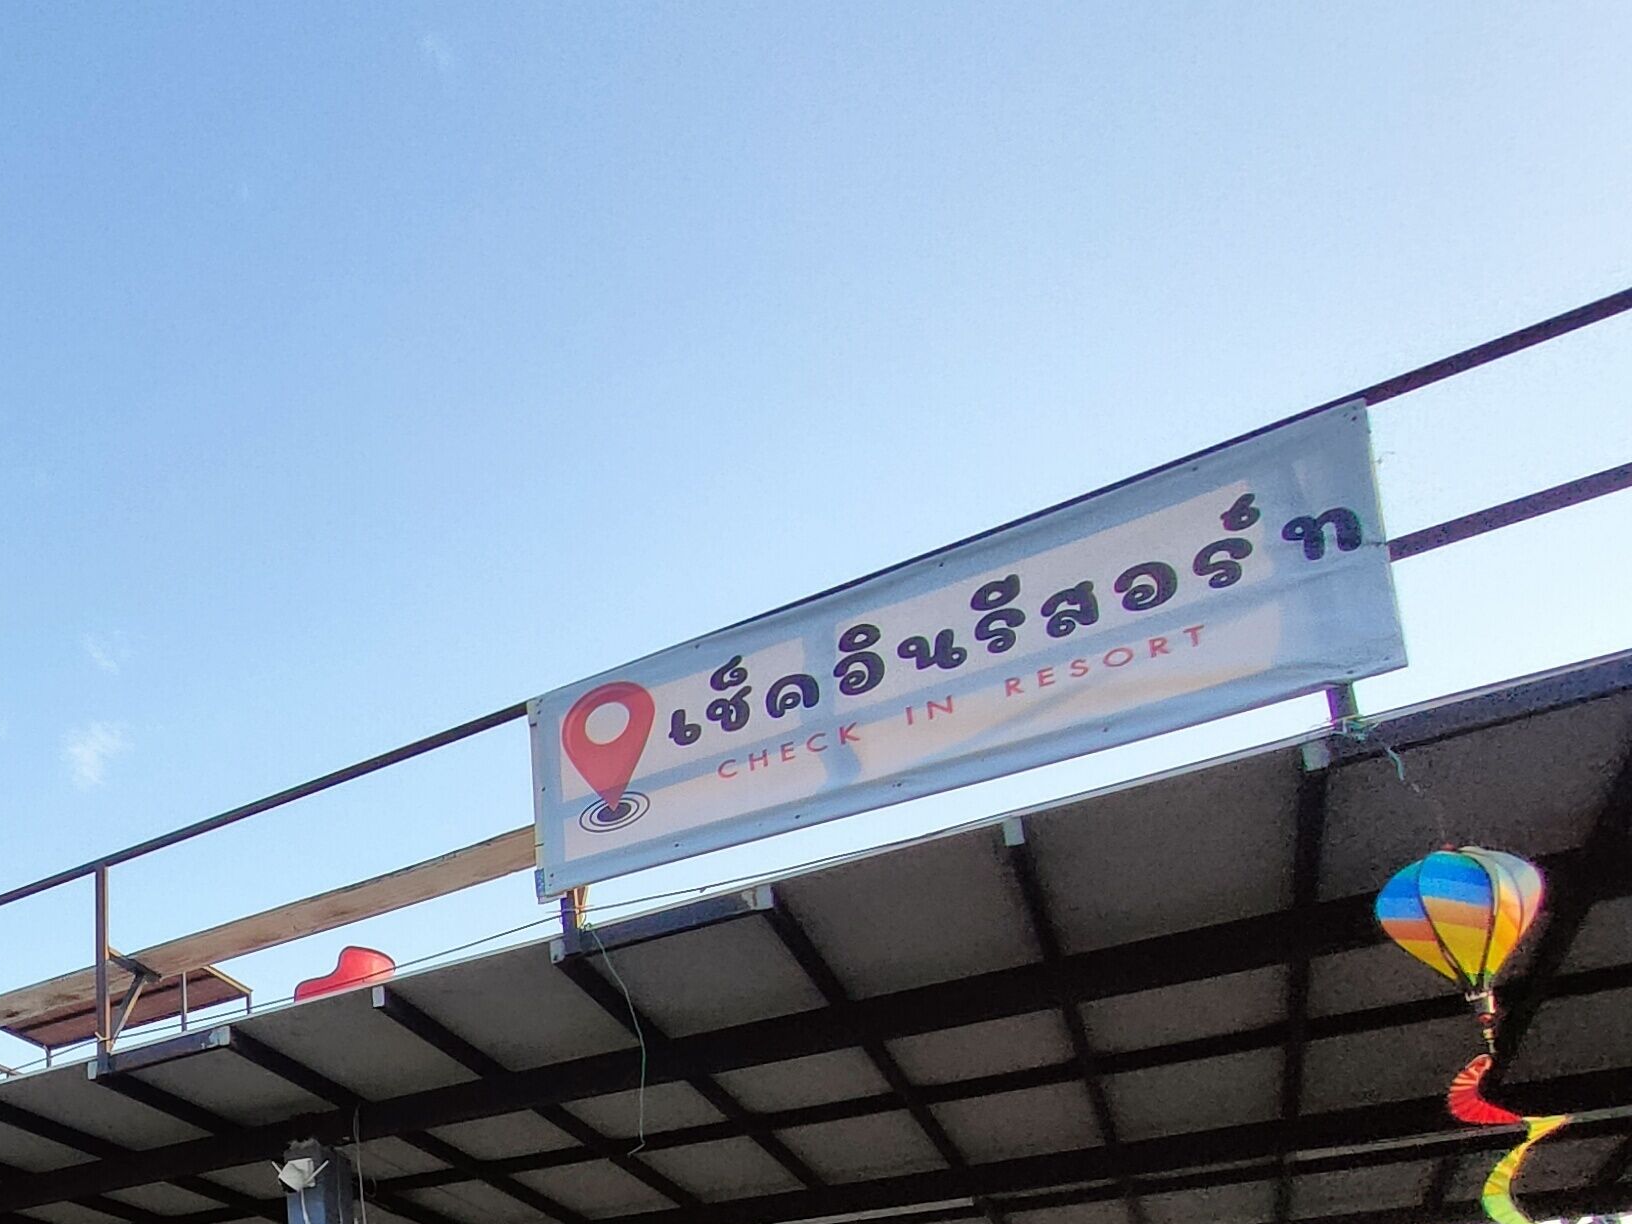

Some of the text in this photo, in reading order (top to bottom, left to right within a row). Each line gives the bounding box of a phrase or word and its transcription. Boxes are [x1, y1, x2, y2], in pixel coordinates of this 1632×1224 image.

[717, 624, 1206, 779] CHECK IN RESORT
